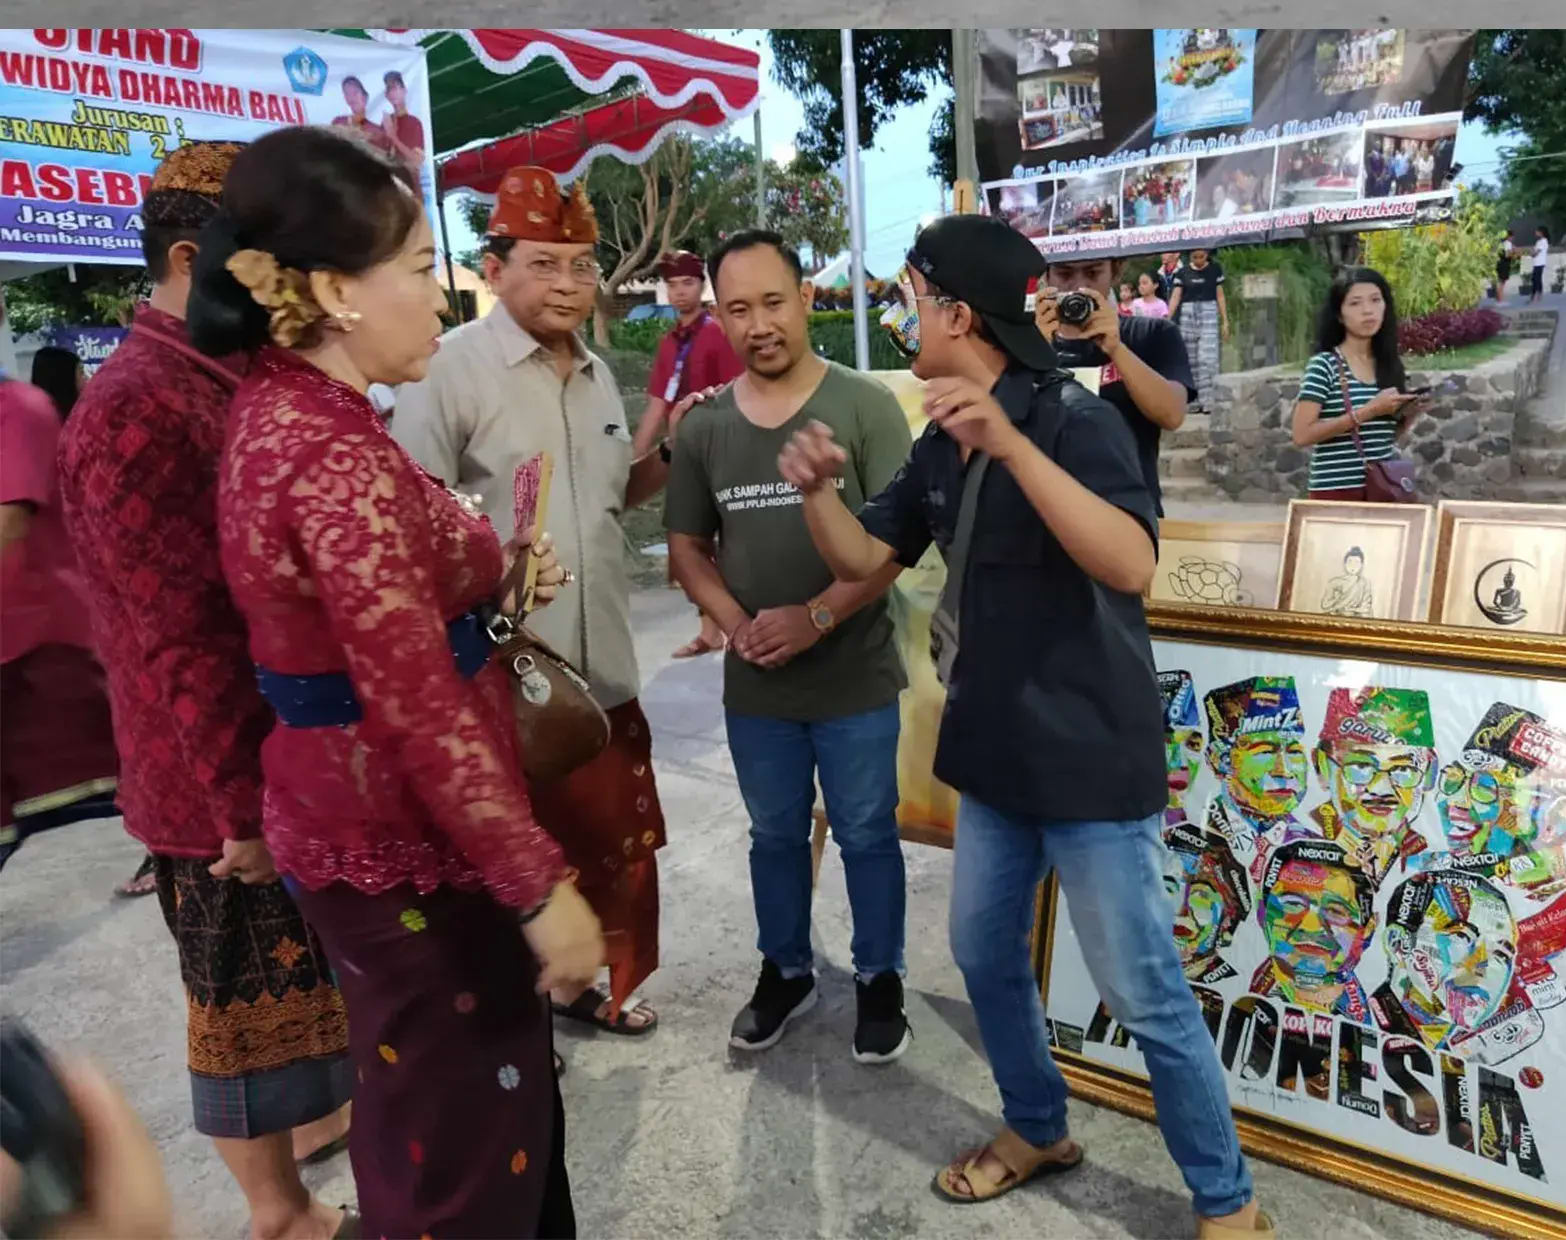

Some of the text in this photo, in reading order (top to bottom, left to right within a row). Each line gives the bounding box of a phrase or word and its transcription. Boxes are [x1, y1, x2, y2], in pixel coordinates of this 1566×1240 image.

[0, 50, 304, 125] WIDYA DHARMA BALI
[72, 99, 169, 134] Jurusan
[17, 205, 114, 231] Jagra
[0, 226, 144, 250] Membangun
[732, 482, 774, 500] SAMPAH
[776, 481, 799, 495] GAL
